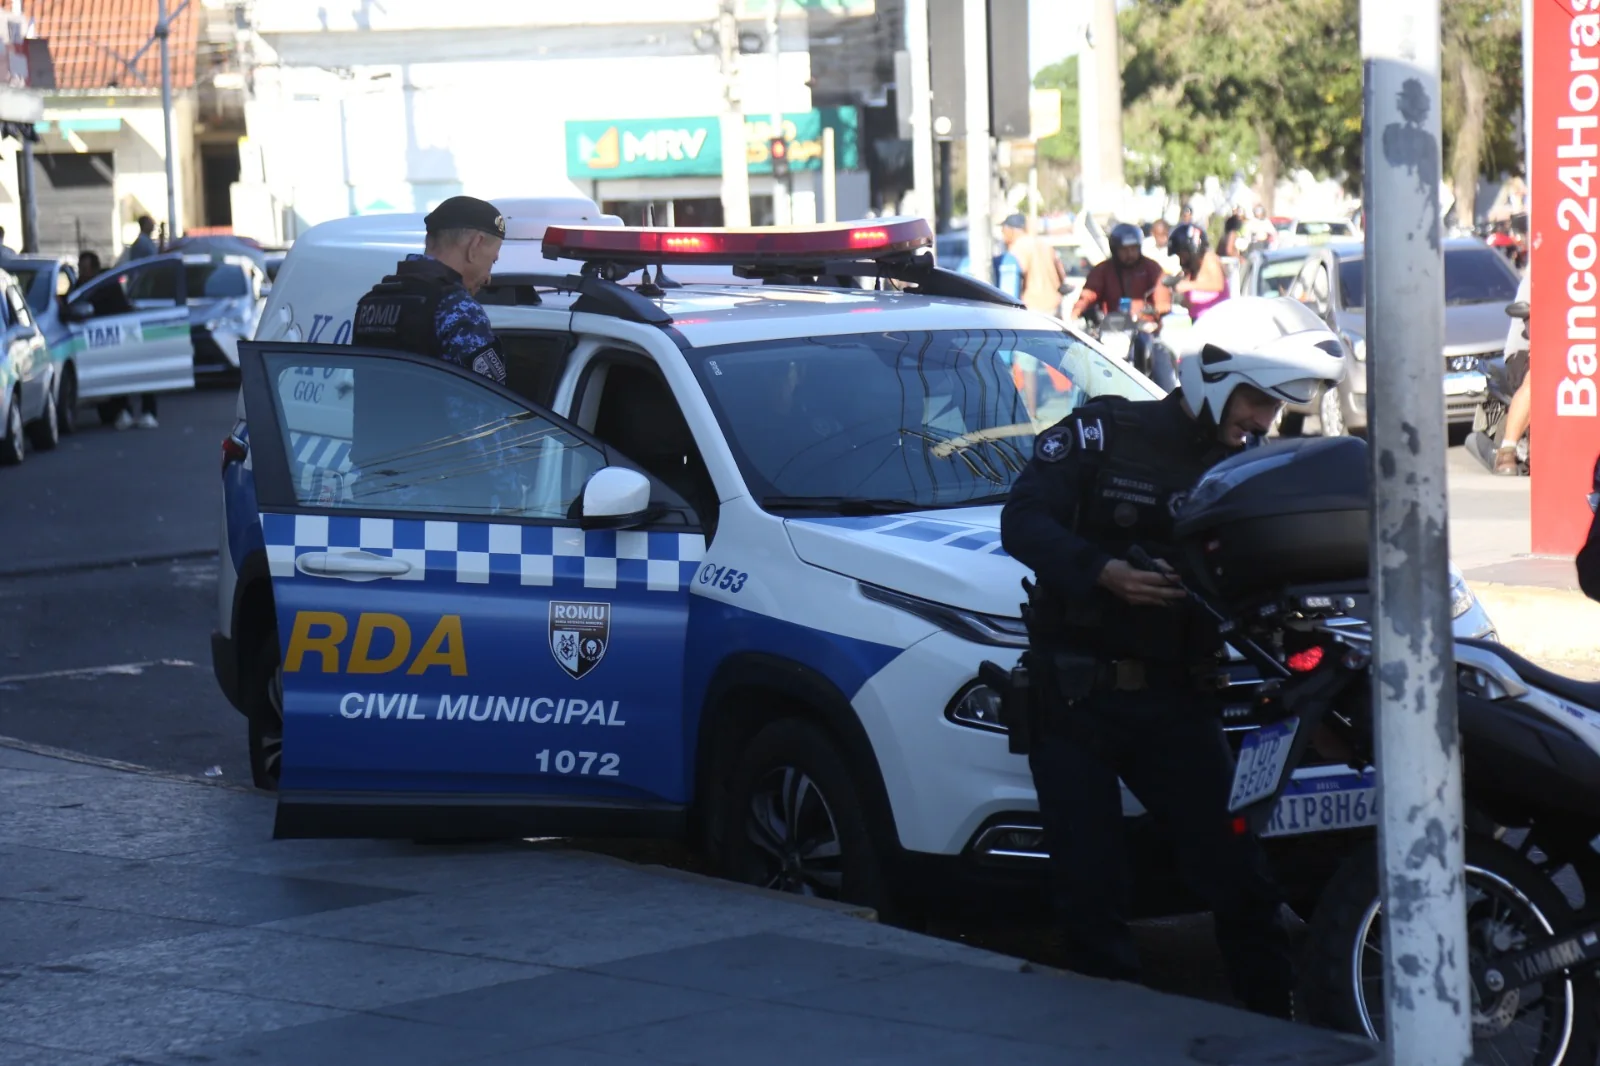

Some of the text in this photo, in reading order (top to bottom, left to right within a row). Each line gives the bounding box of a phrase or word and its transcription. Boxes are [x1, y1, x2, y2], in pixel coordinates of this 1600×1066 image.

[623, 128, 708, 163] MRV
[358, 303, 402, 326] ROMU
[87, 324, 121, 348] TAXI
[293, 380, 325, 404] GOC
[711, 566, 749, 594] 153
[555, 605, 605, 620] ROMU
[283, 611, 468, 677] RDA
[340, 692, 626, 726] CIVIL MUNICIPAL
[535, 749, 621, 777] 1072
[1513, 938, 1586, 980] YAMAHA
